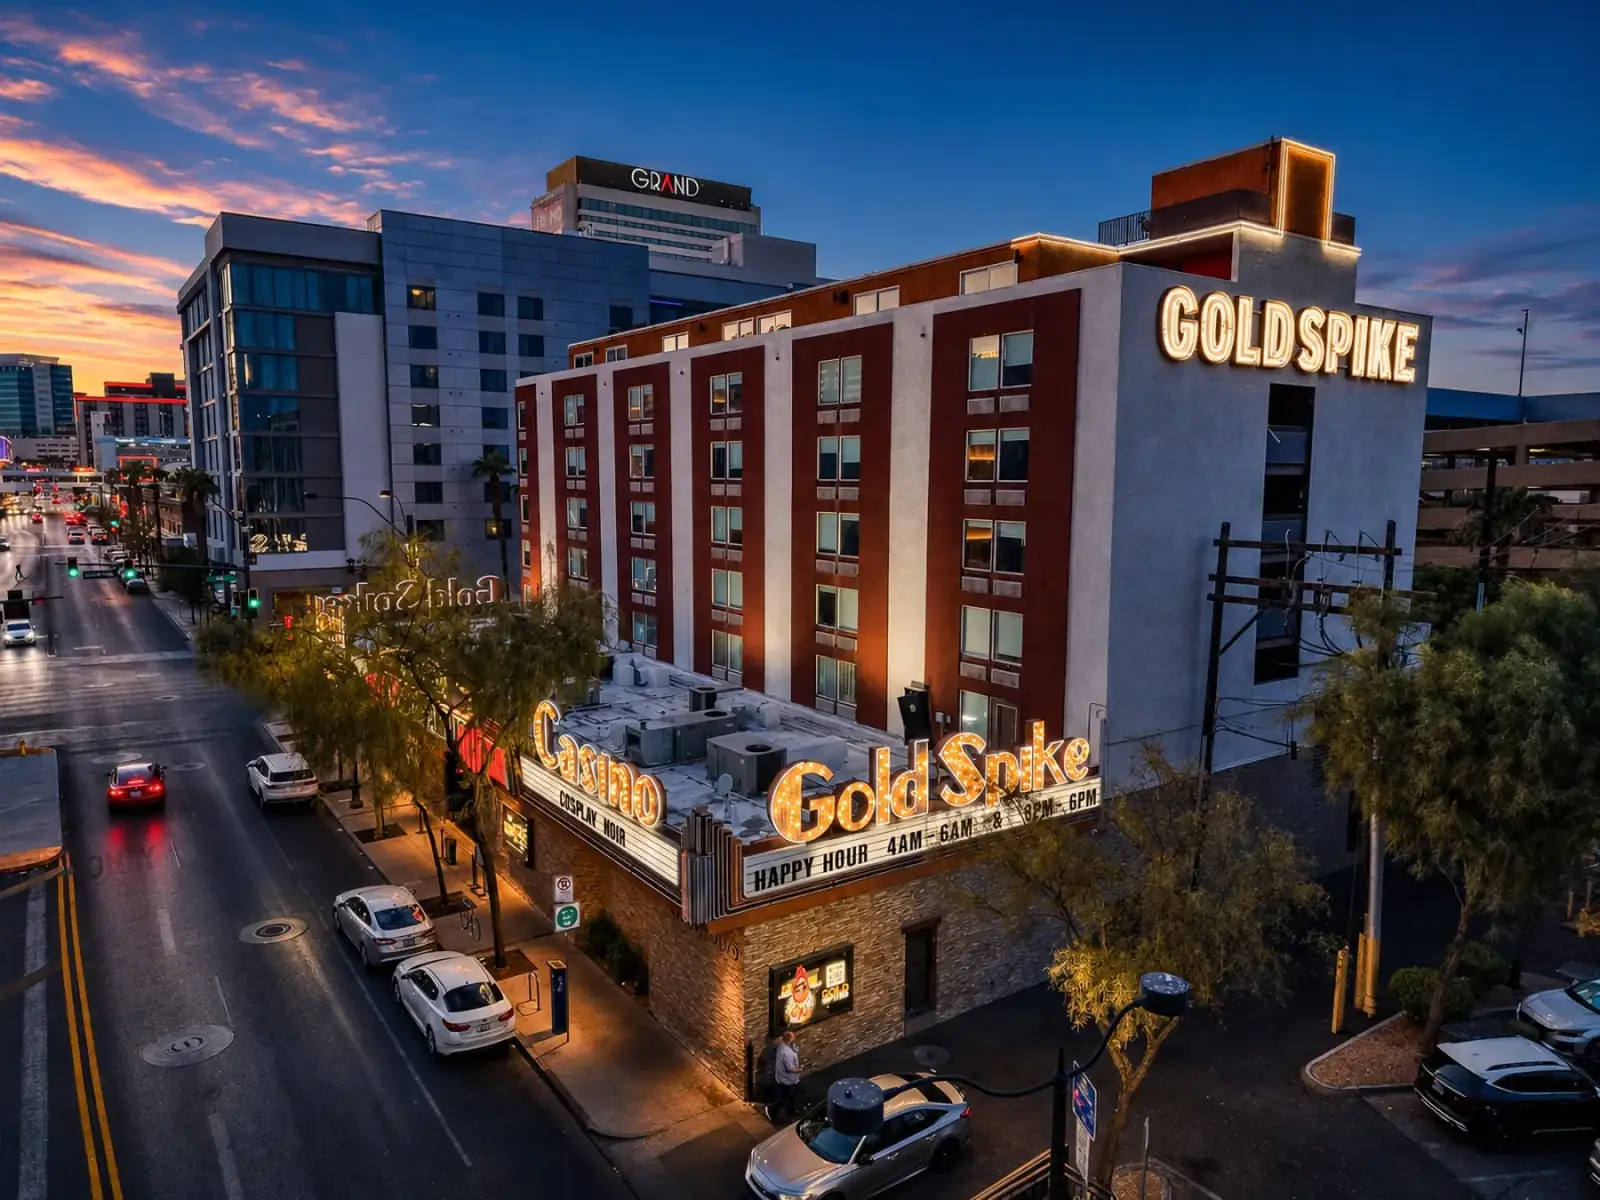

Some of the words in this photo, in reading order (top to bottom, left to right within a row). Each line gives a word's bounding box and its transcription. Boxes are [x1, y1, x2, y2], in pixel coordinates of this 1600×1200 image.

[631, 168, 700, 197] GRAND
[533, 700, 666, 828] Casino
[768, 738, 930, 844] Gold
[935, 720, 1090, 810] Spike
[559, 790, 597, 828] COSPLAY
[603, 816, 626, 848] NOIR
[754, 856, 814, 892] HAPPY
[823, 843, 868, 872] HOUR
[887, 830, 923, 856] 4AM
[940, 817, 973, 842] 6AM
[992, 811, 1003, 829] &
[1069, 787, 1097, 811] 6PM
